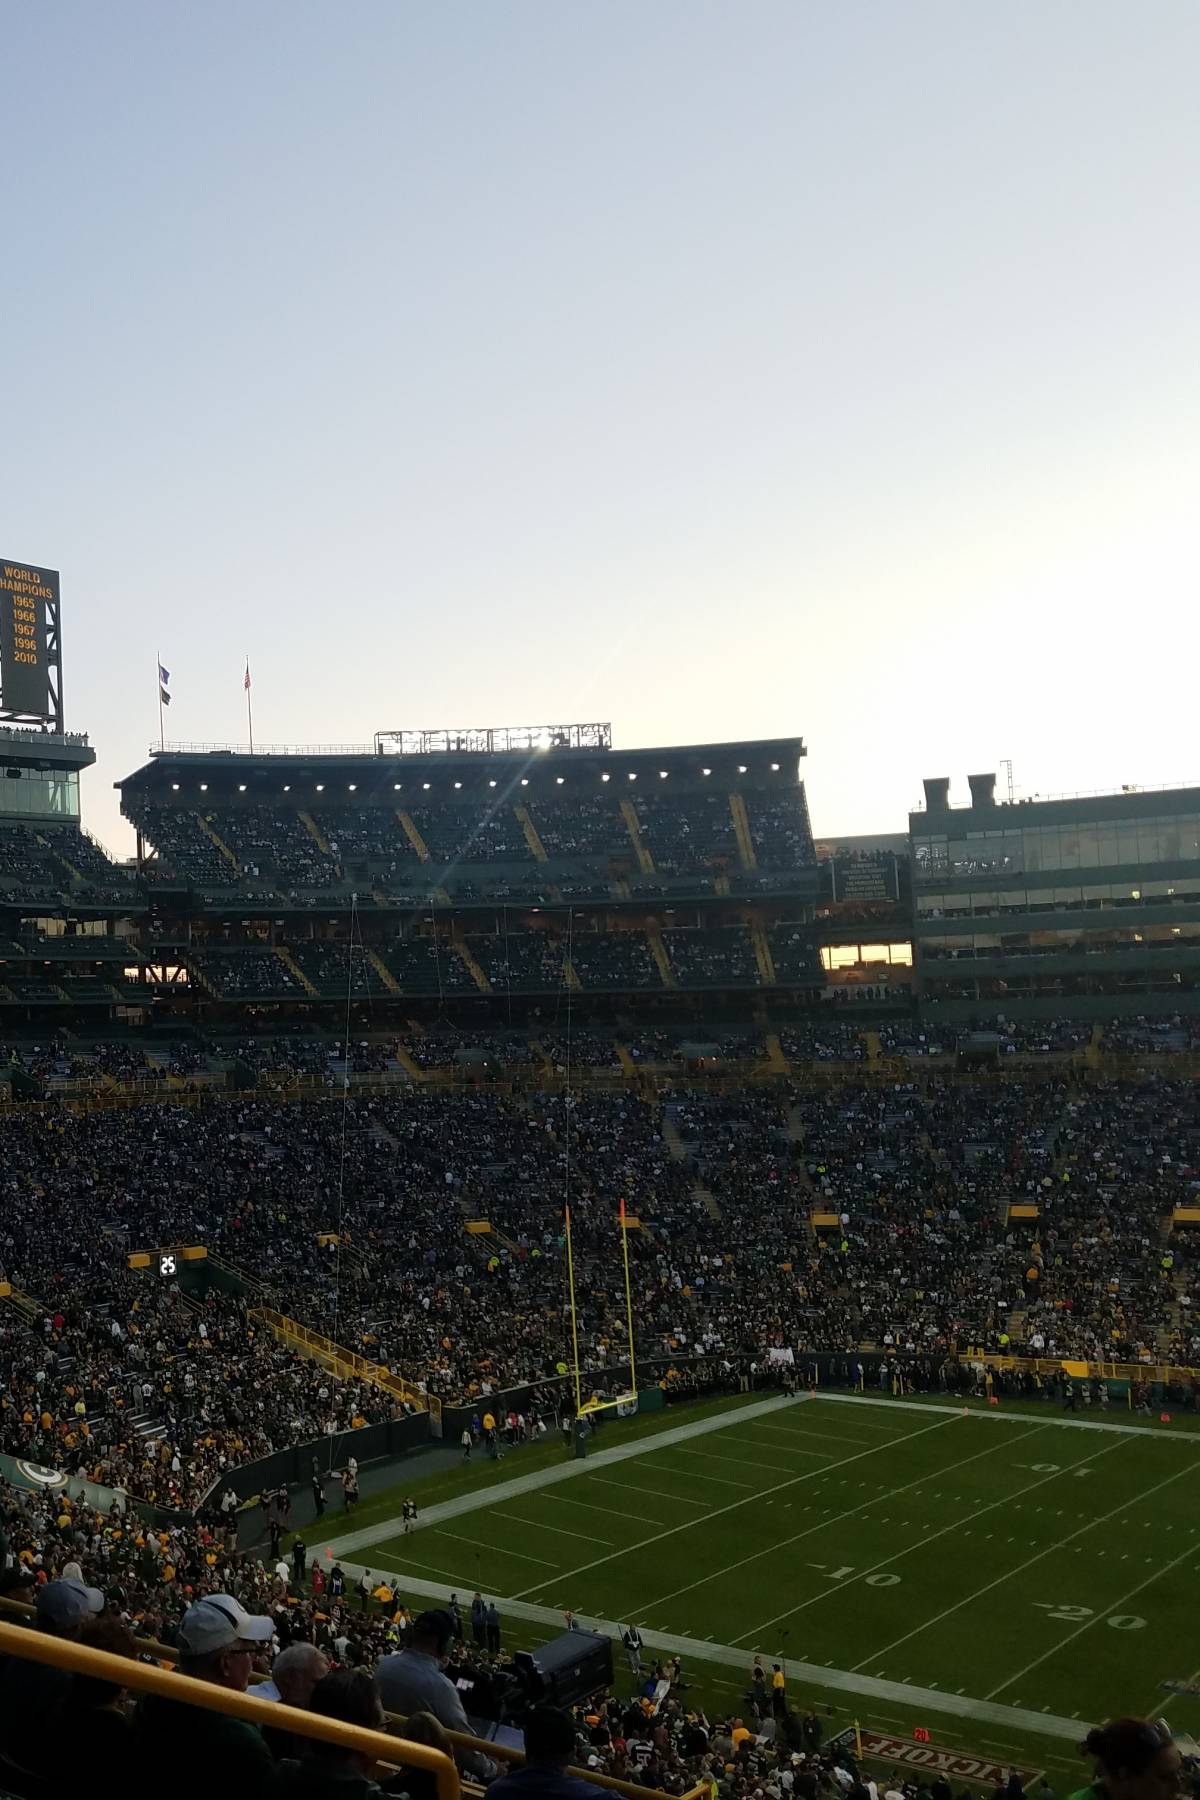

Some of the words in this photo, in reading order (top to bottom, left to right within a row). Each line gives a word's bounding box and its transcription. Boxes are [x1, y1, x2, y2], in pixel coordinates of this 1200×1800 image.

[4, 566, 40, 584] WORLD
[12, 595, 35, 609] 1965
[12, 608, 36, 623] 1966
[13, 622, 35, 637] 1967
[13, 636, 37, 651] 1996
[14, 651, 37, 664] 2010
[161, 1256, 176, 1274] 25
[822, 1566, 902, 1587] 10
[1046, 1605, 1148, 1630] 20
[915, 1728, 927, 1741] 20
